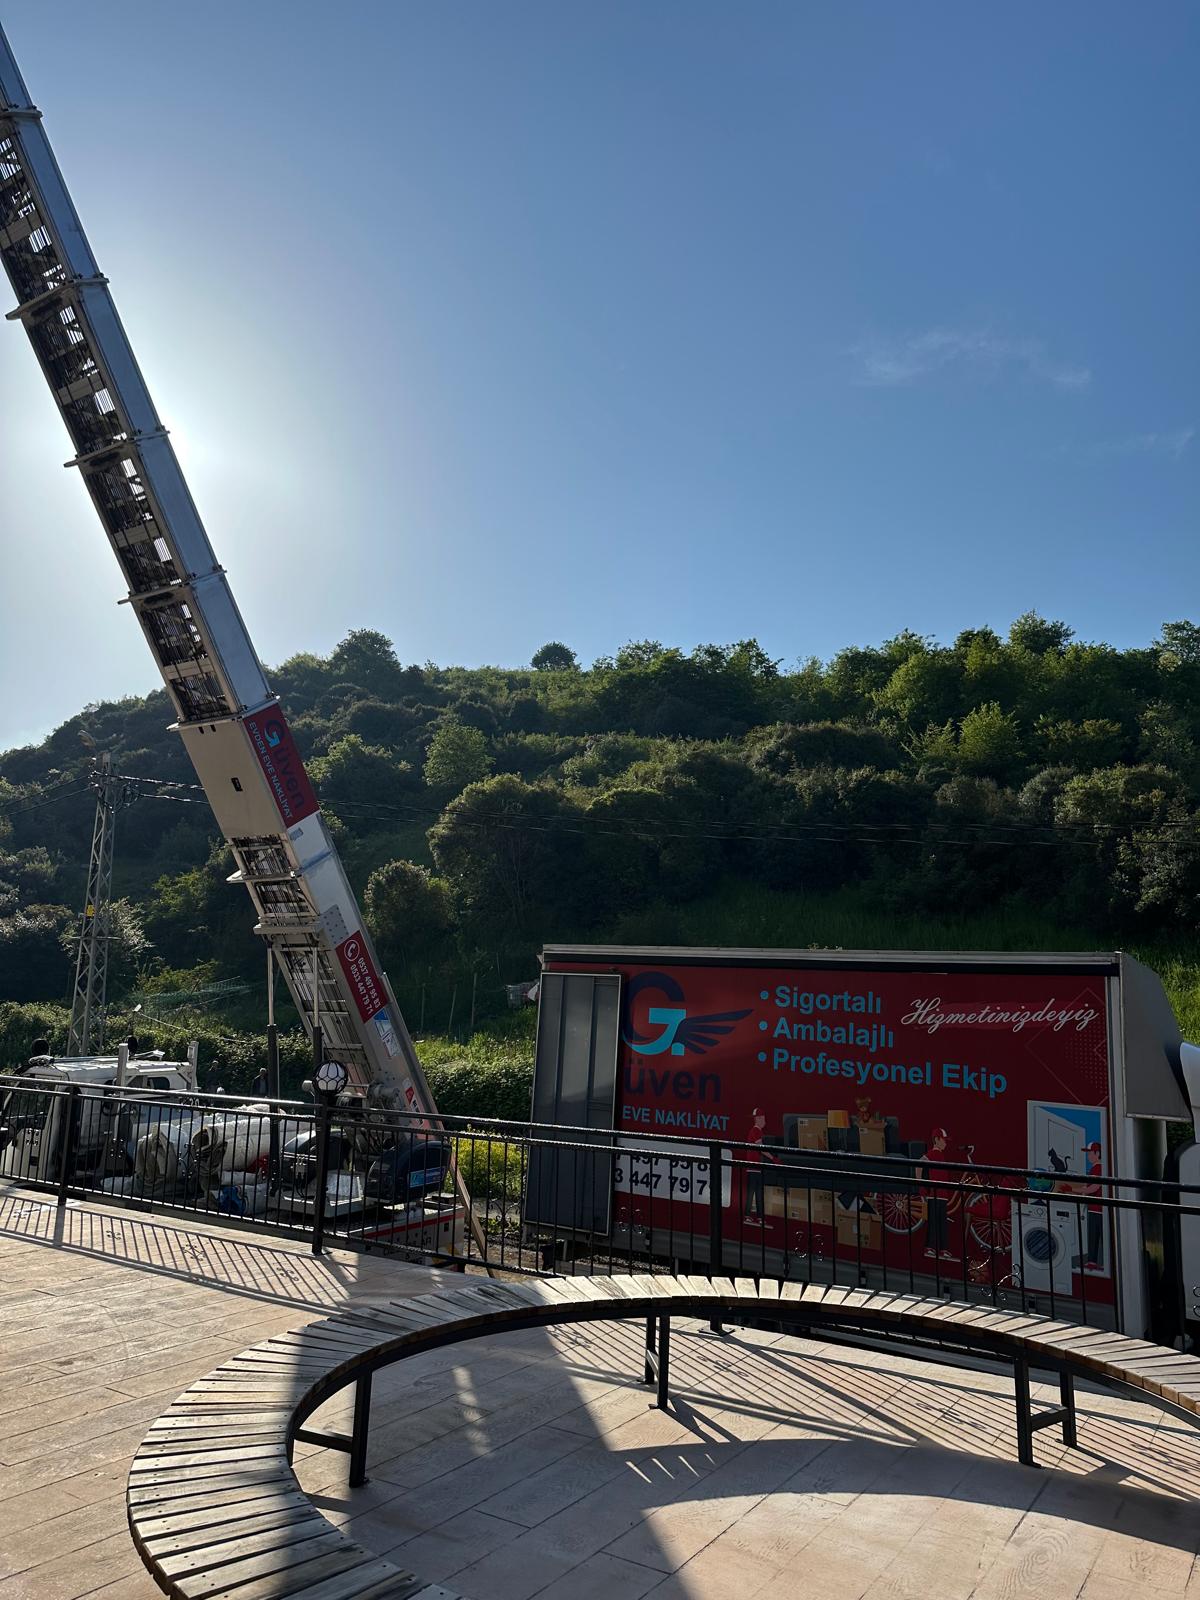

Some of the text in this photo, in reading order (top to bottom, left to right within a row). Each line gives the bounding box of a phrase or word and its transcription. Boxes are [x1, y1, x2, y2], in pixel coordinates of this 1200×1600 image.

[249, 721, 266, 754] EVDEN
[263, 755, 275, 774] EVE
[350, 964, 374, 1014] 0533 447 79 71
[357, 957, 381, 1008] 0537 497 95 83
[775, 985, 881, 1014] Sigortalı
[901, 997, 1099, 1034] Hizmetinizdeyiz
[773, 1017, 894, 1052] Ambalajlı
[773, 1048, 1007, 1098] Profesyonel Ekip
[622, 1105, 730, 1132] EVE NAKLİYAT
[630, 1171, 662, 1189] 447
[668, 1176, 690, 1193] 79
